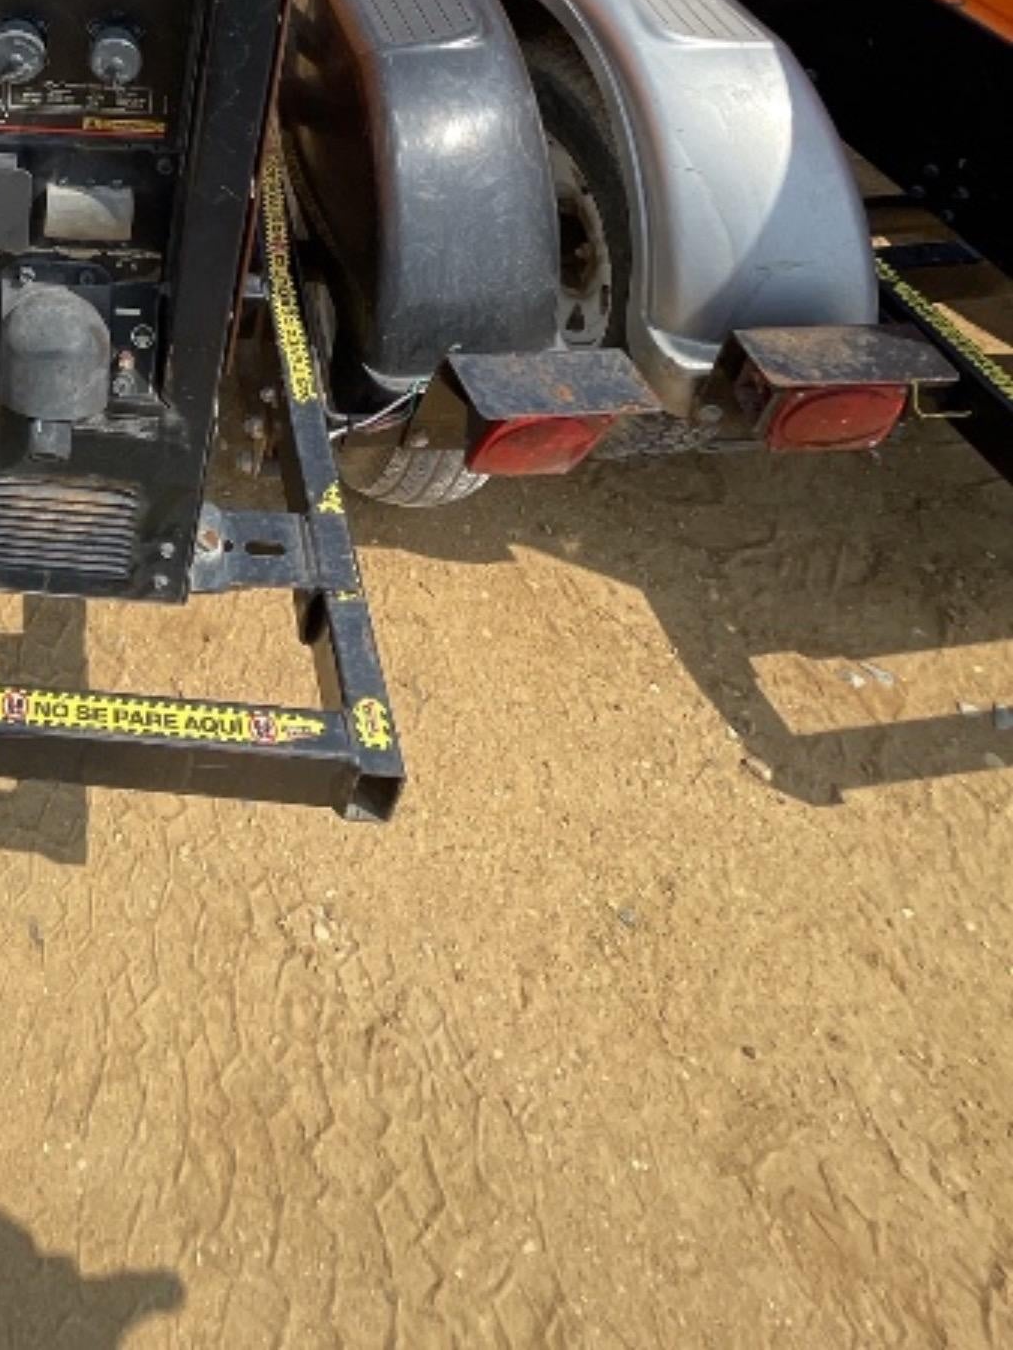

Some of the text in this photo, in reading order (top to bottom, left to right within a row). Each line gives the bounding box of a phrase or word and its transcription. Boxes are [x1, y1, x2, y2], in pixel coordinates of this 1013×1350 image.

[33, 699, 69, 719] NO
[75, 704, 108, 724] SE
[112, 709, 180, 731] PARE
